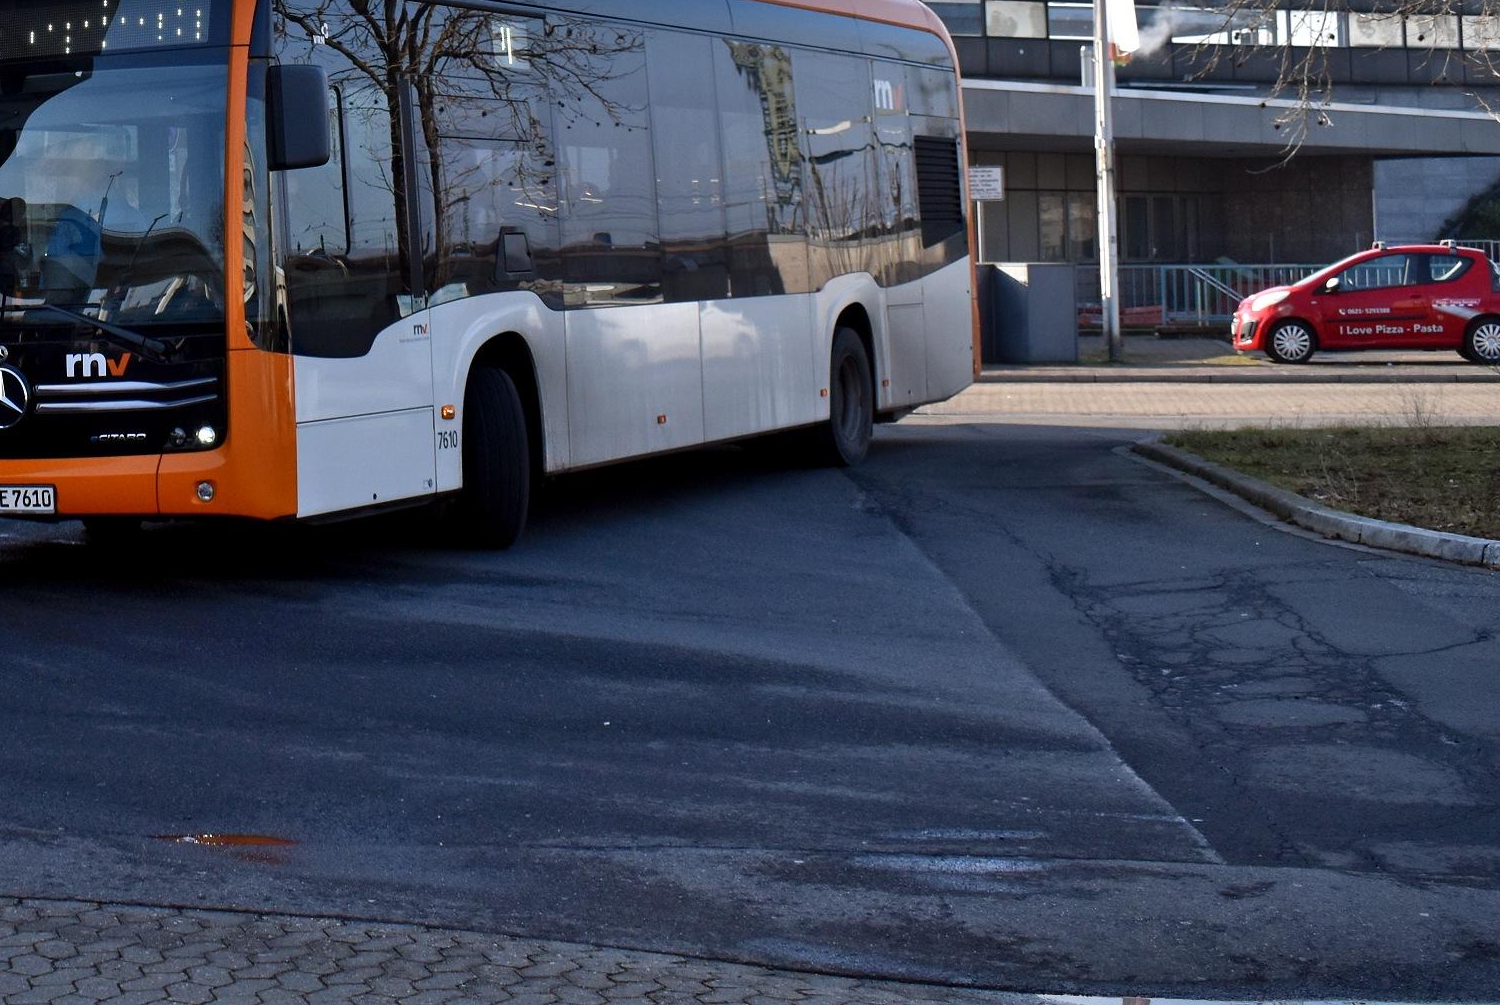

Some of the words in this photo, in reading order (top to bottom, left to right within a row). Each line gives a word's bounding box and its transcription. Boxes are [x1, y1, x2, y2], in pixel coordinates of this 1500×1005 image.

[1346, 326, 1373, 335] Love
[1375, 324, 1404, 334] Pizza
[1413, 323, 1444, 333] Pasta
[65, 352, 131, 378] rnv
[437, 430, 458, 450] 7610
[0, 490, 10, 508] E
[12, 490, 52, 508] 7610
